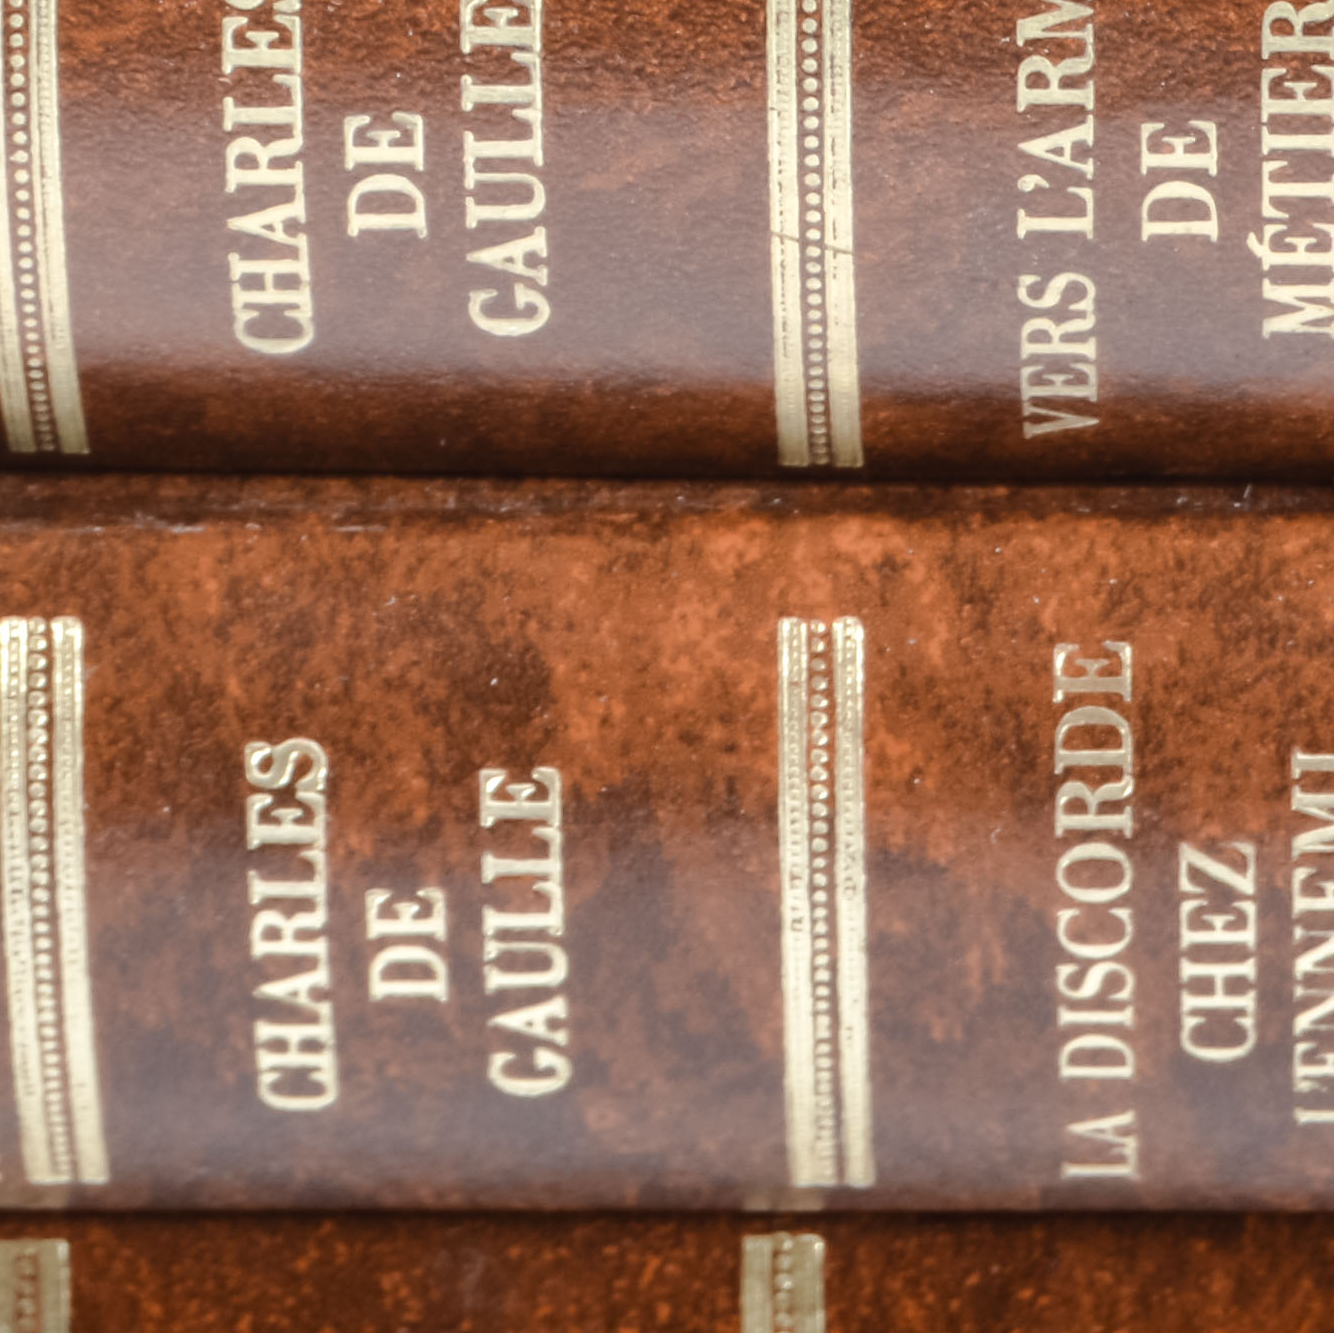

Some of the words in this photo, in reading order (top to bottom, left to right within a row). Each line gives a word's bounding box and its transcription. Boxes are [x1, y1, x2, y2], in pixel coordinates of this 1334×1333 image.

[345, 111, 426, 239] DE
[1142, 118, 1217, 242] DE
[1023, 272, 1097, 439] VERS
[244, 738, 339, 1112] CHARLES
[480, 766, 573, 1097] GAULLE
[1053, 640, 1134, 1081] DISCORDE
[366, 888, 447, 1001] DE
[1178, 841, 1257, 1063] CHEZ
[1061, 1110, 1139, 1181] LA
